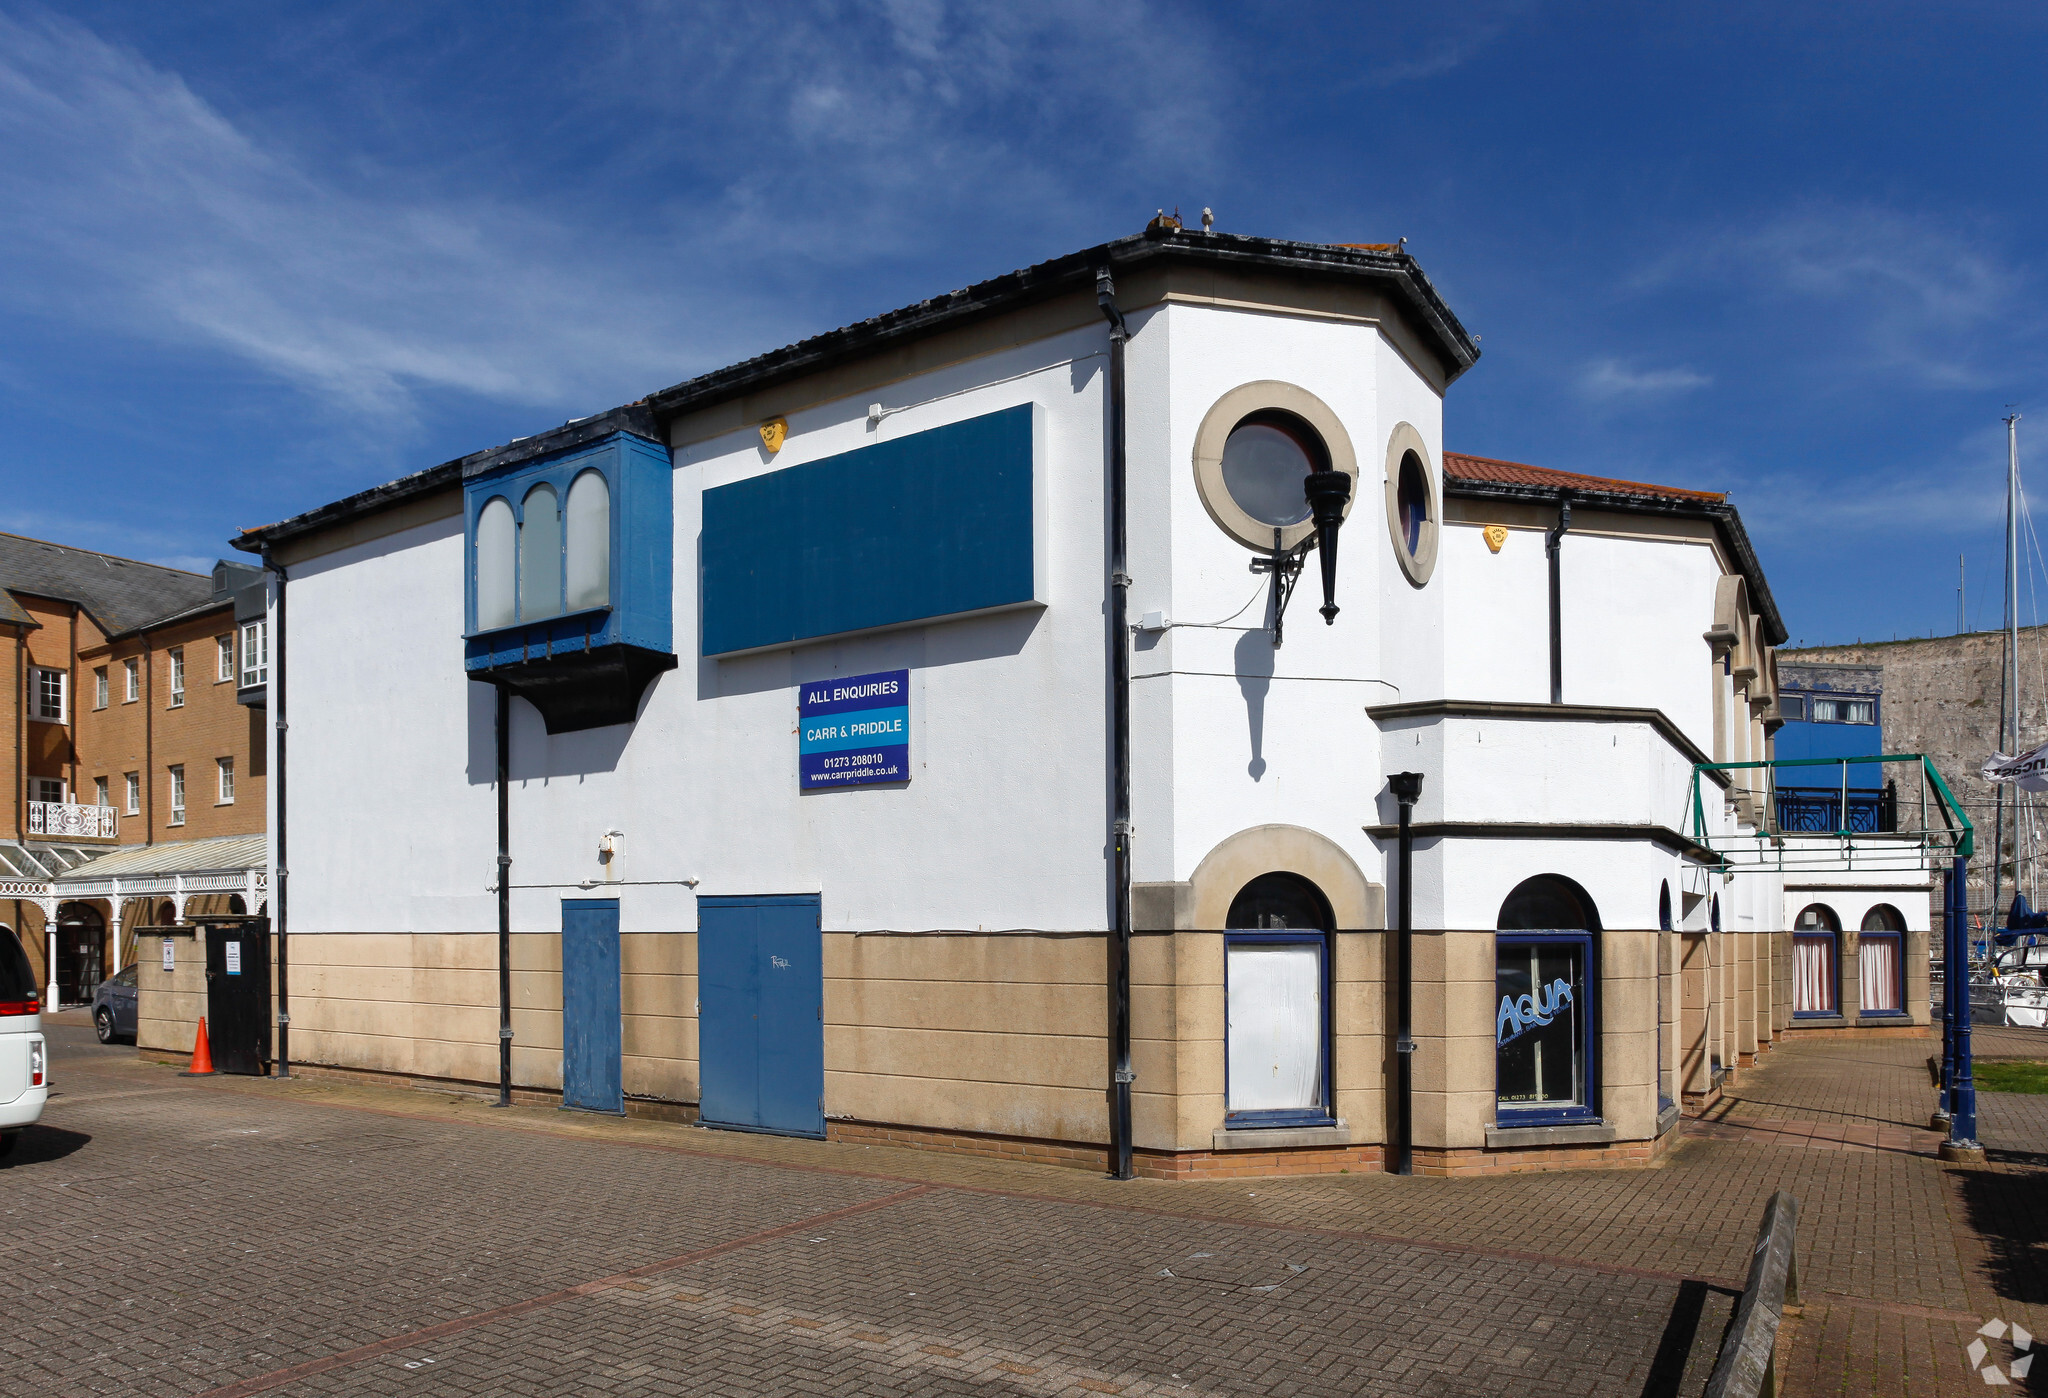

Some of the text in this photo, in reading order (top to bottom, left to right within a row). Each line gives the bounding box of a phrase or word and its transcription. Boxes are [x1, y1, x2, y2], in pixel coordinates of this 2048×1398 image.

[808, 680, 899, 704] ALL ENQUIRIES
[807, 719, 902, 741] CARR & PRIDDLE
[824, 753, 883, 768] 01273 208010
[811, 765, 898, 781] www.carrpriddle.co.uk
[1497, 978, 1573, 1044] AQUA
